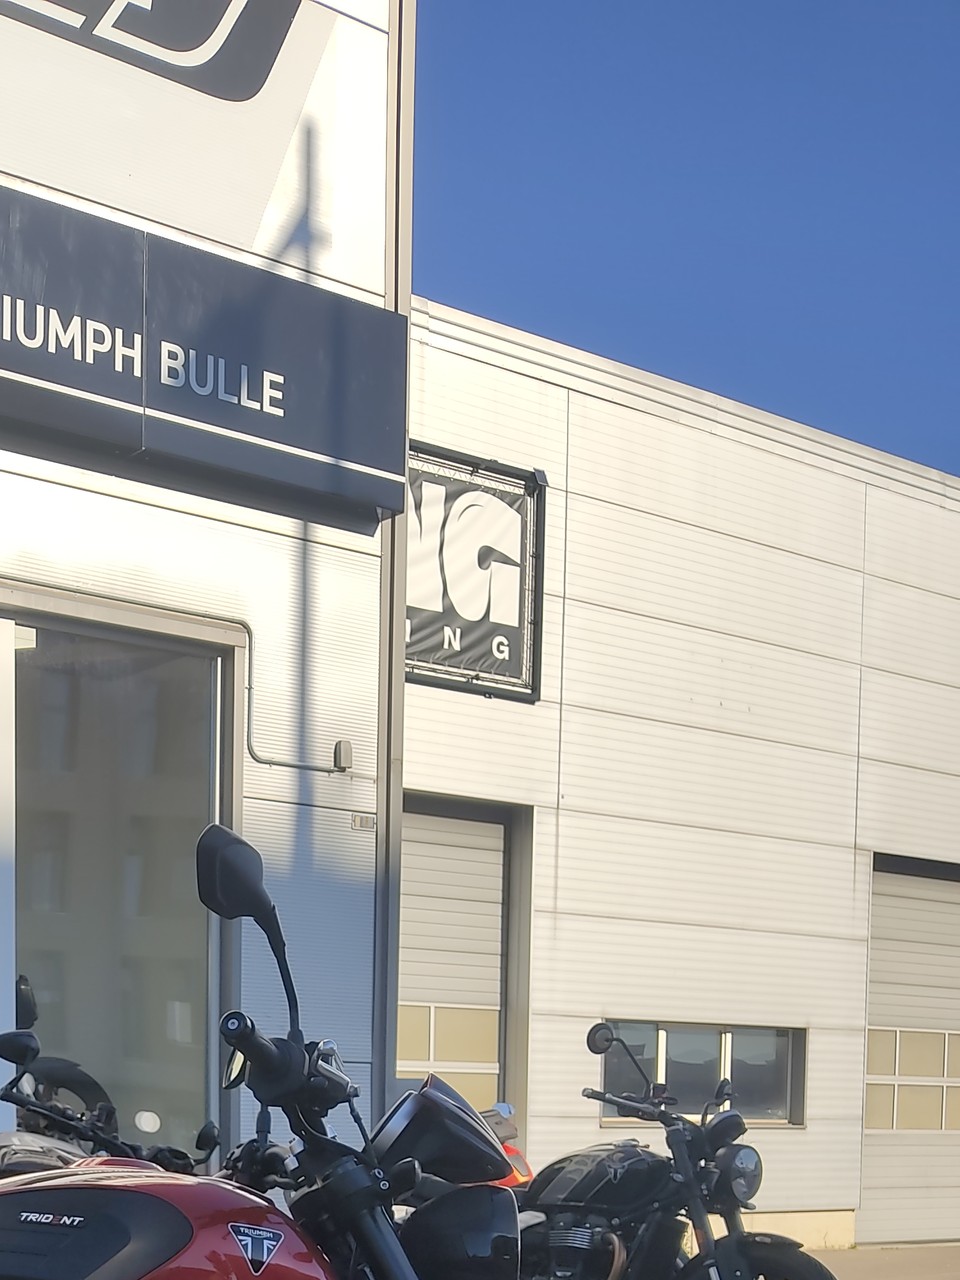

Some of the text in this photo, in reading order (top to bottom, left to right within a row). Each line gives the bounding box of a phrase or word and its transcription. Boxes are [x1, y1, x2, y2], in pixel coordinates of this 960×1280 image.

[160, 340, 286, 418] BULLE
[18, 1211, 84, 1227] TRIDENT
[239, 1226, 274, 1238] TRIUMPH
